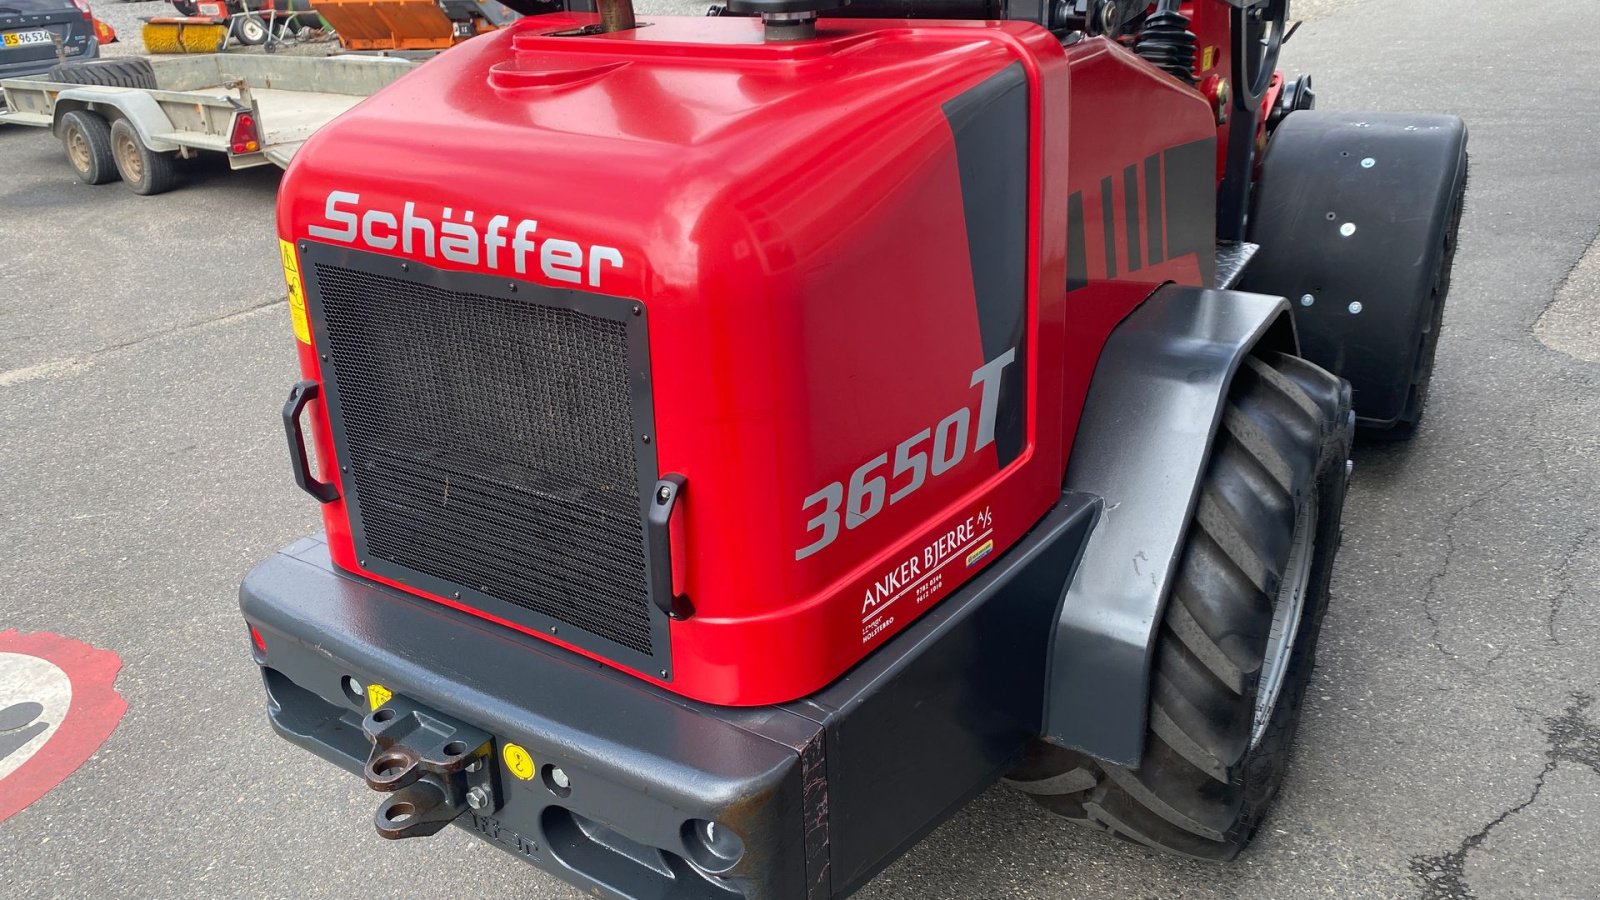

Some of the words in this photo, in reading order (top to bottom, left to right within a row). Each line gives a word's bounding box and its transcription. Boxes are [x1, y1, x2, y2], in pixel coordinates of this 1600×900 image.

[3, 34, 19, 45] BS
[19, 33, 32, 43] 96
[308, 190, 624, 287] Schäffer
[795, 346, 1017, 561] 3650T
[861, 555, 921, 615] ANKER
[924, 516, 975, 569] BJERRE
[976, 505, 993, 529] A/S
[862, 616, 895, 644] HOLSTEBRO
